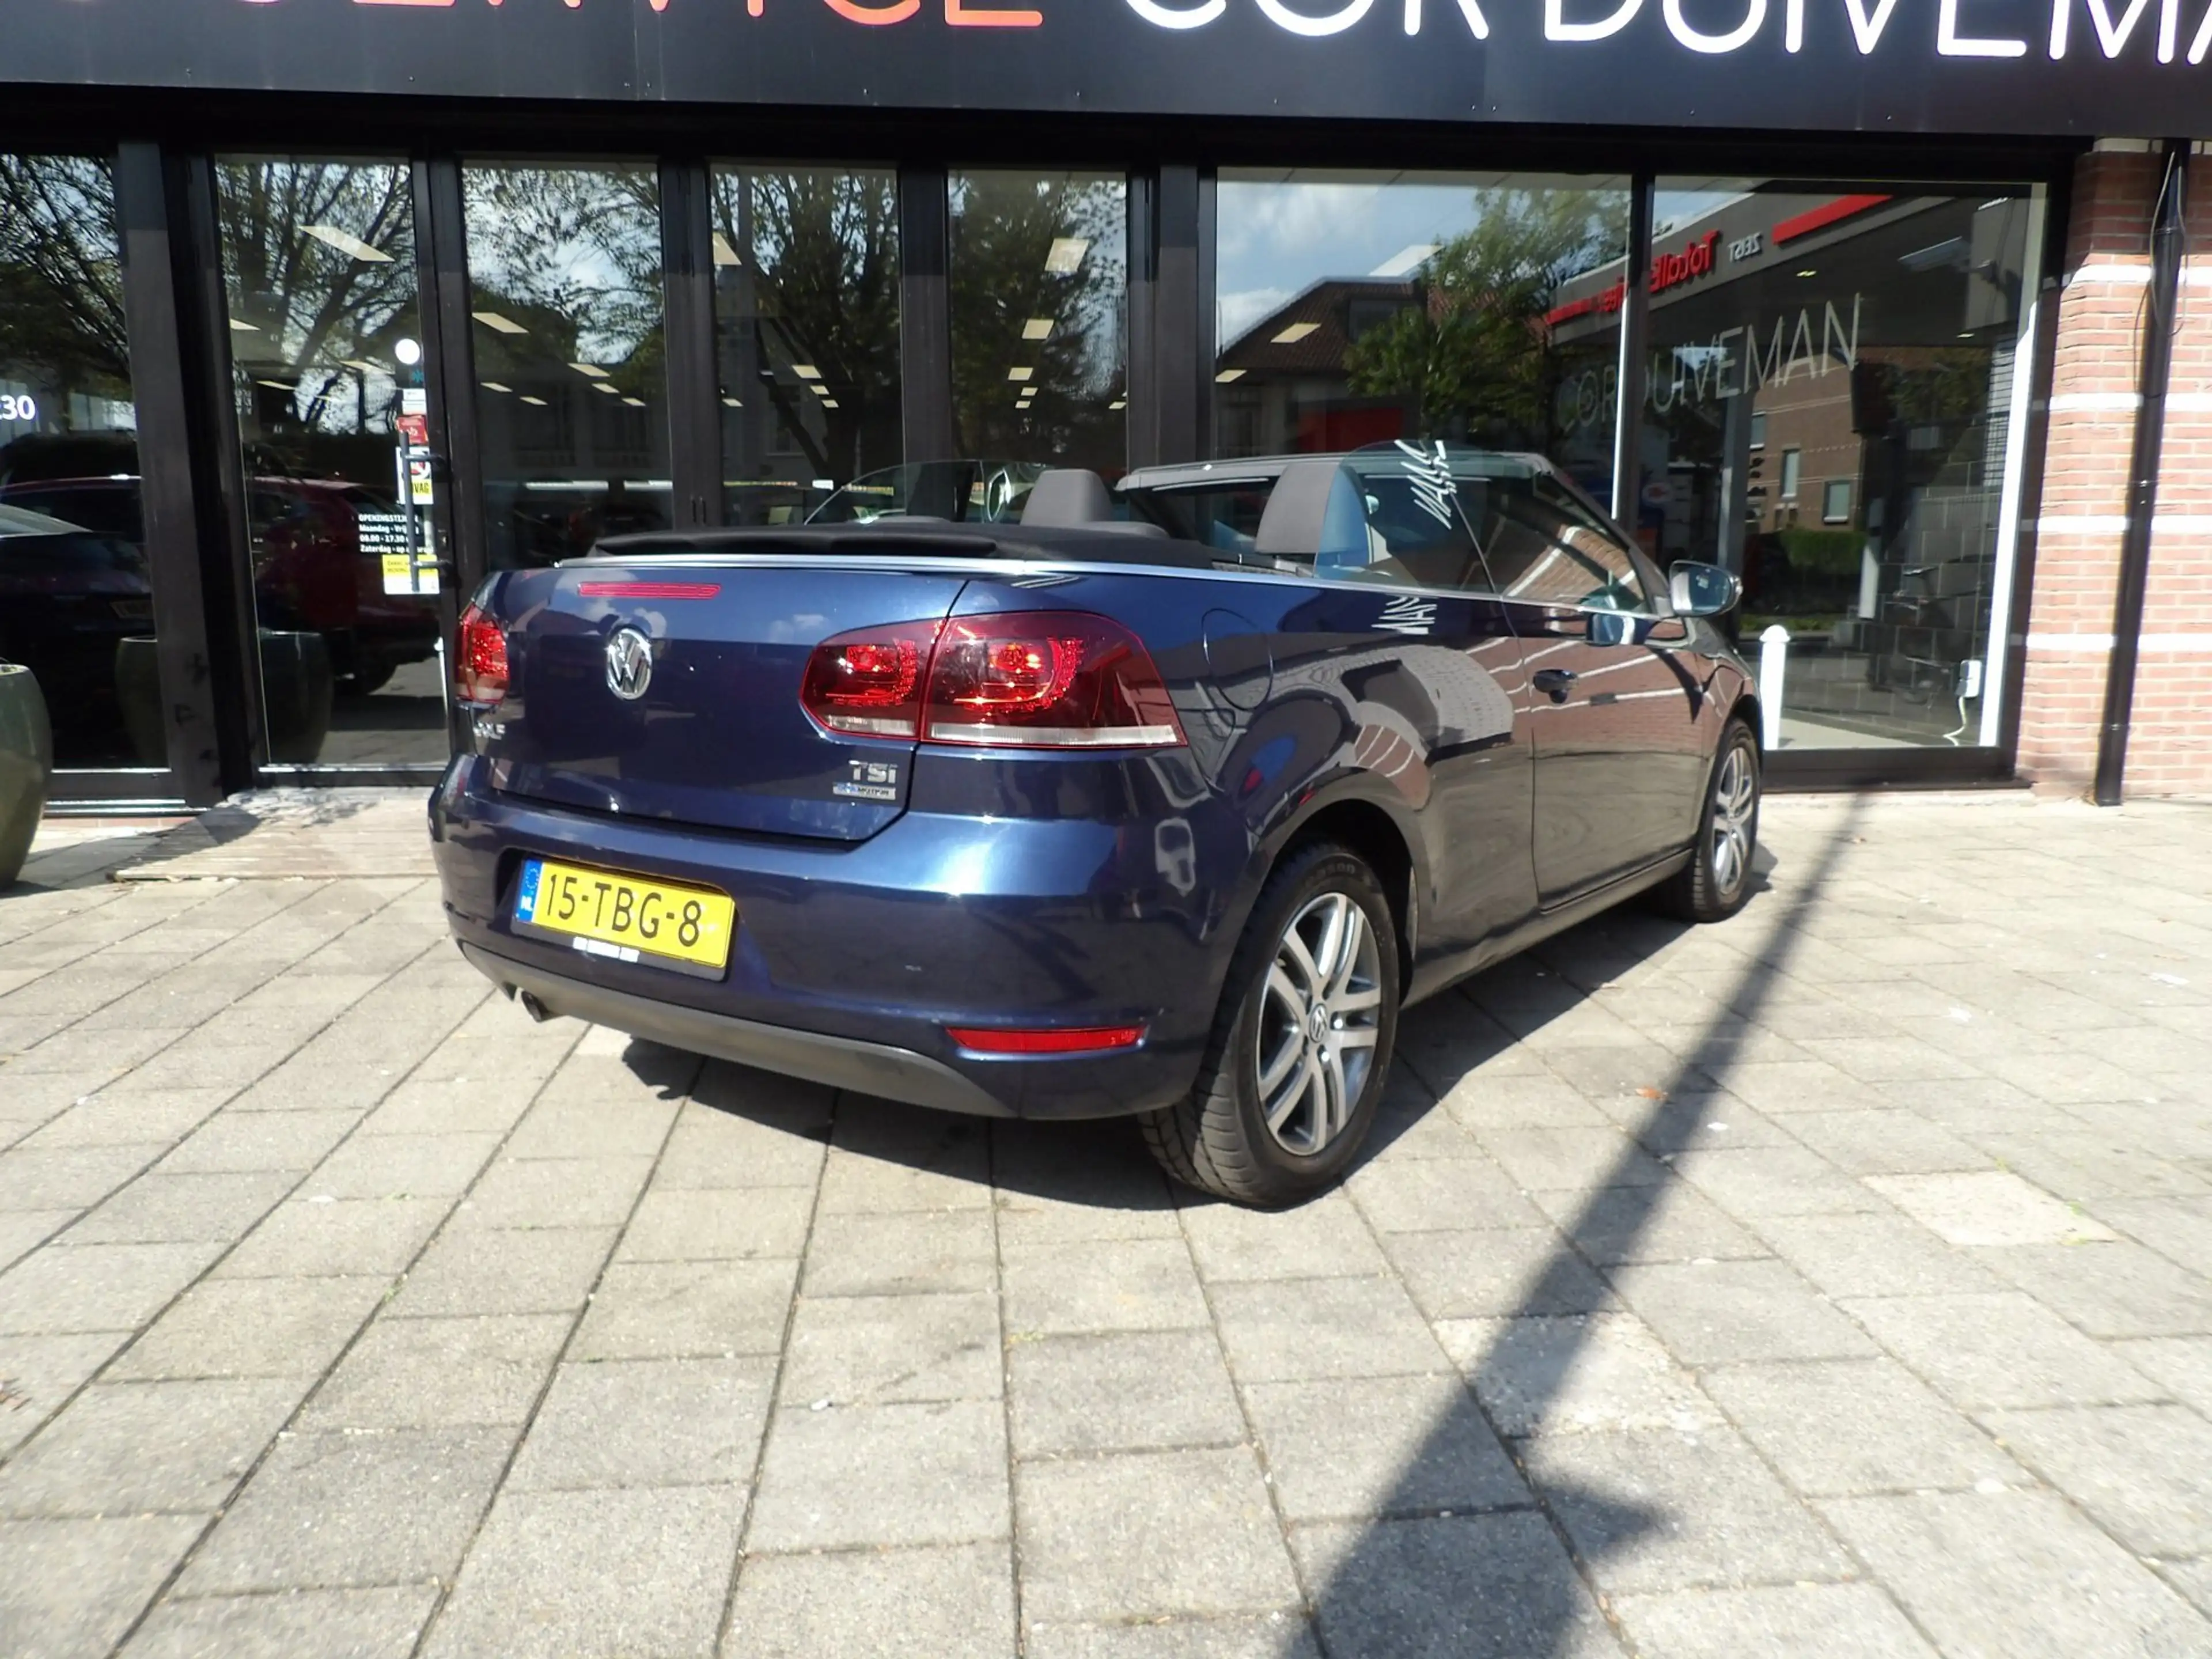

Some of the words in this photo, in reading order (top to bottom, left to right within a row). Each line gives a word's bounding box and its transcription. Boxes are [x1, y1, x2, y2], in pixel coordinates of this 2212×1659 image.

[1643, 292, 1861, 414] UIVEMAN
[411, 482, 430, 494] VAG
[358, 514, 419, 522] OPENINGSTIJD
[547, 874, 702, 948] 15-TBG-8
